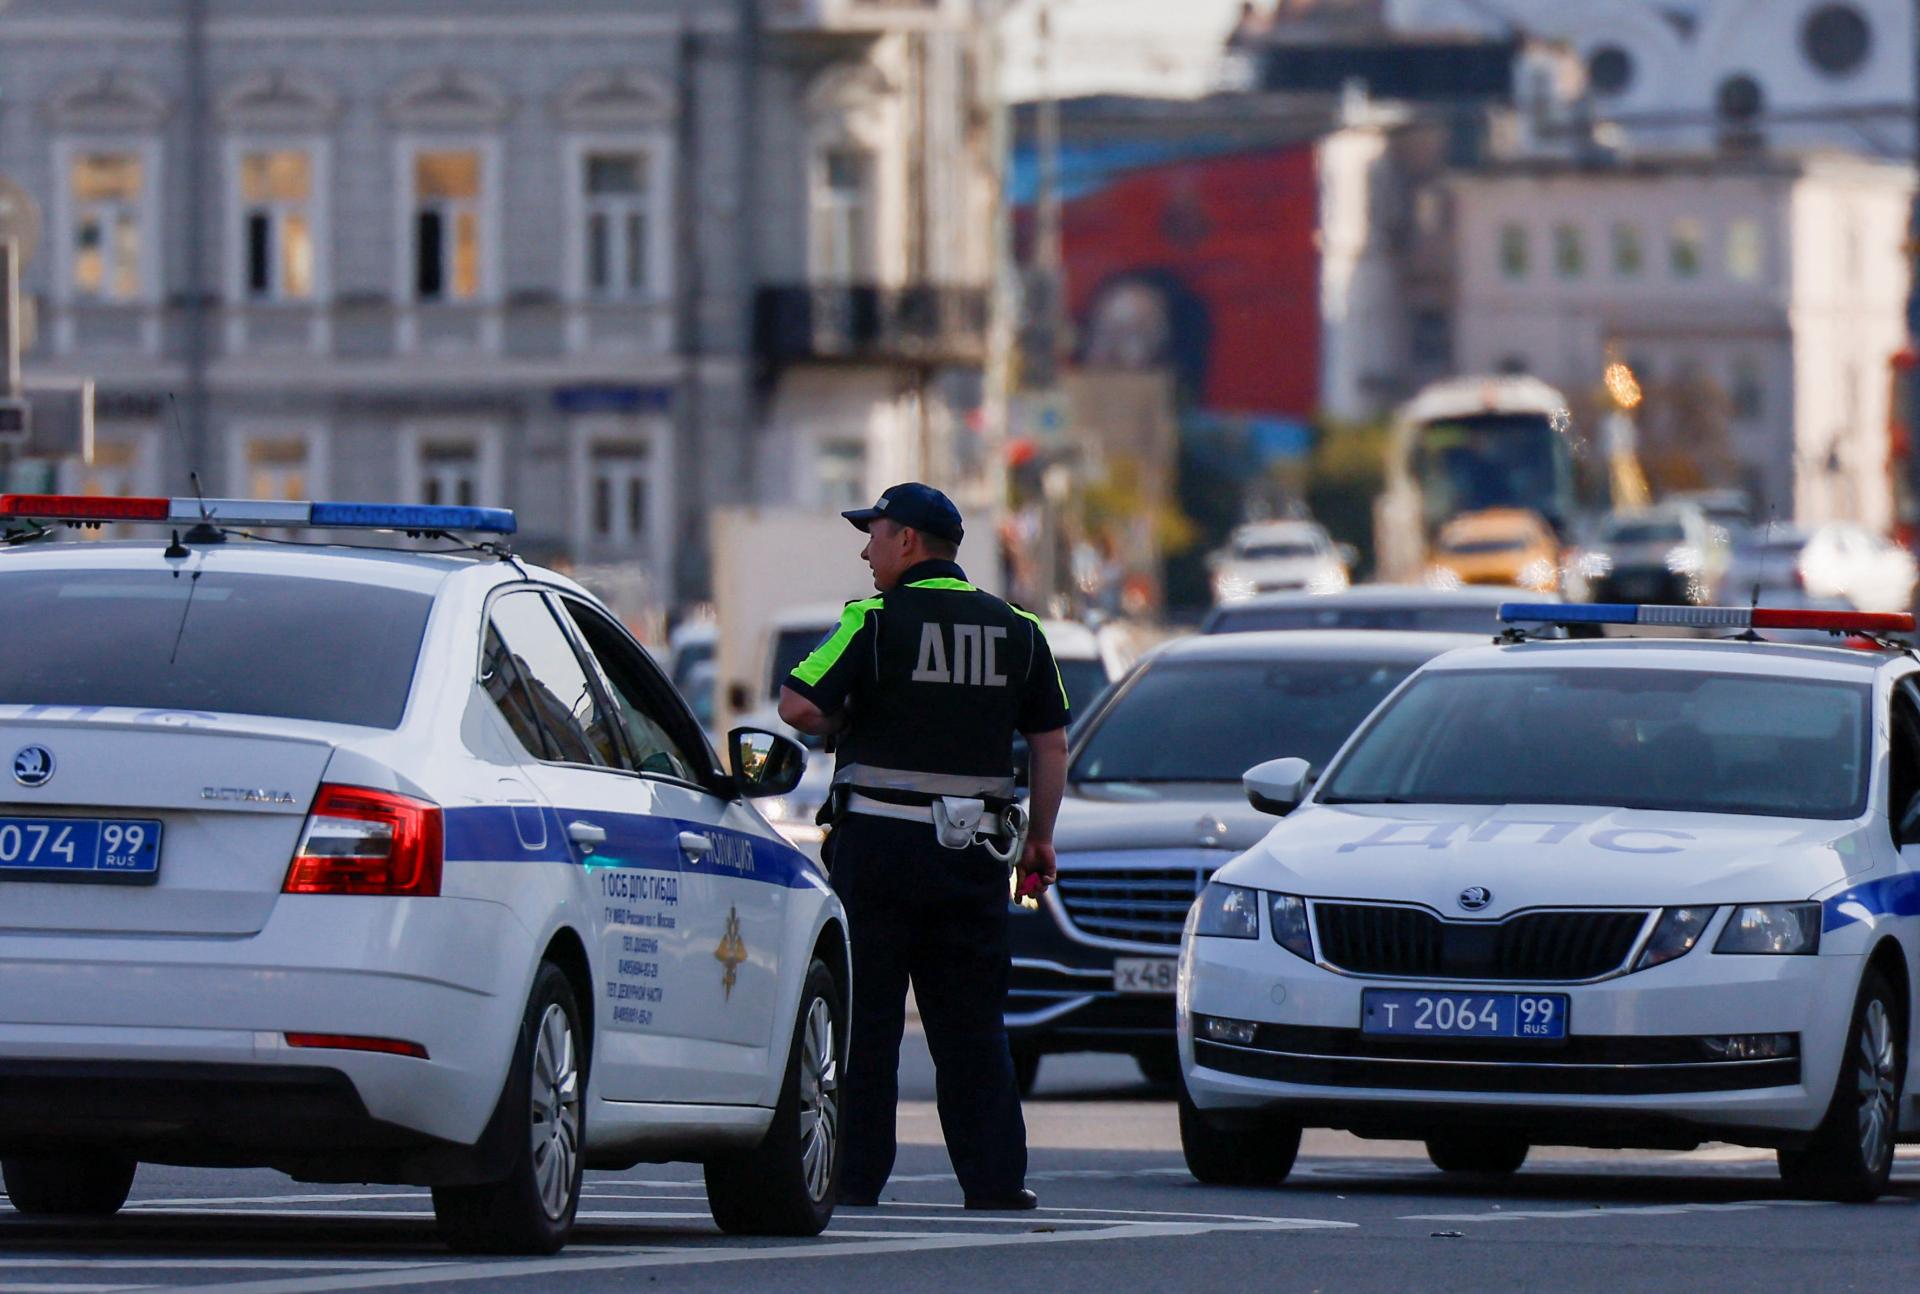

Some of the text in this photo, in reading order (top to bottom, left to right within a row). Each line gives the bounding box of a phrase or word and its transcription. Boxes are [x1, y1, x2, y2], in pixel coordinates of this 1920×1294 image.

[912, 622, 1007, 687] ДПС
[0, 824, 145, 863] 074 99
[703, 831, 755, 876] ПОЛИЦИЯ
[1336, 819, 1697, 854] ДПС
[105, 854, 136, 866] RUS
[601, 872, 678, 907] 1 ОСБ ДПС ГИБДД
[1413, 997, 1498, 1031] 2064
[1520, 998, 1554, 1024] 99
[1523, 1024, 1548, 1034] RUS
